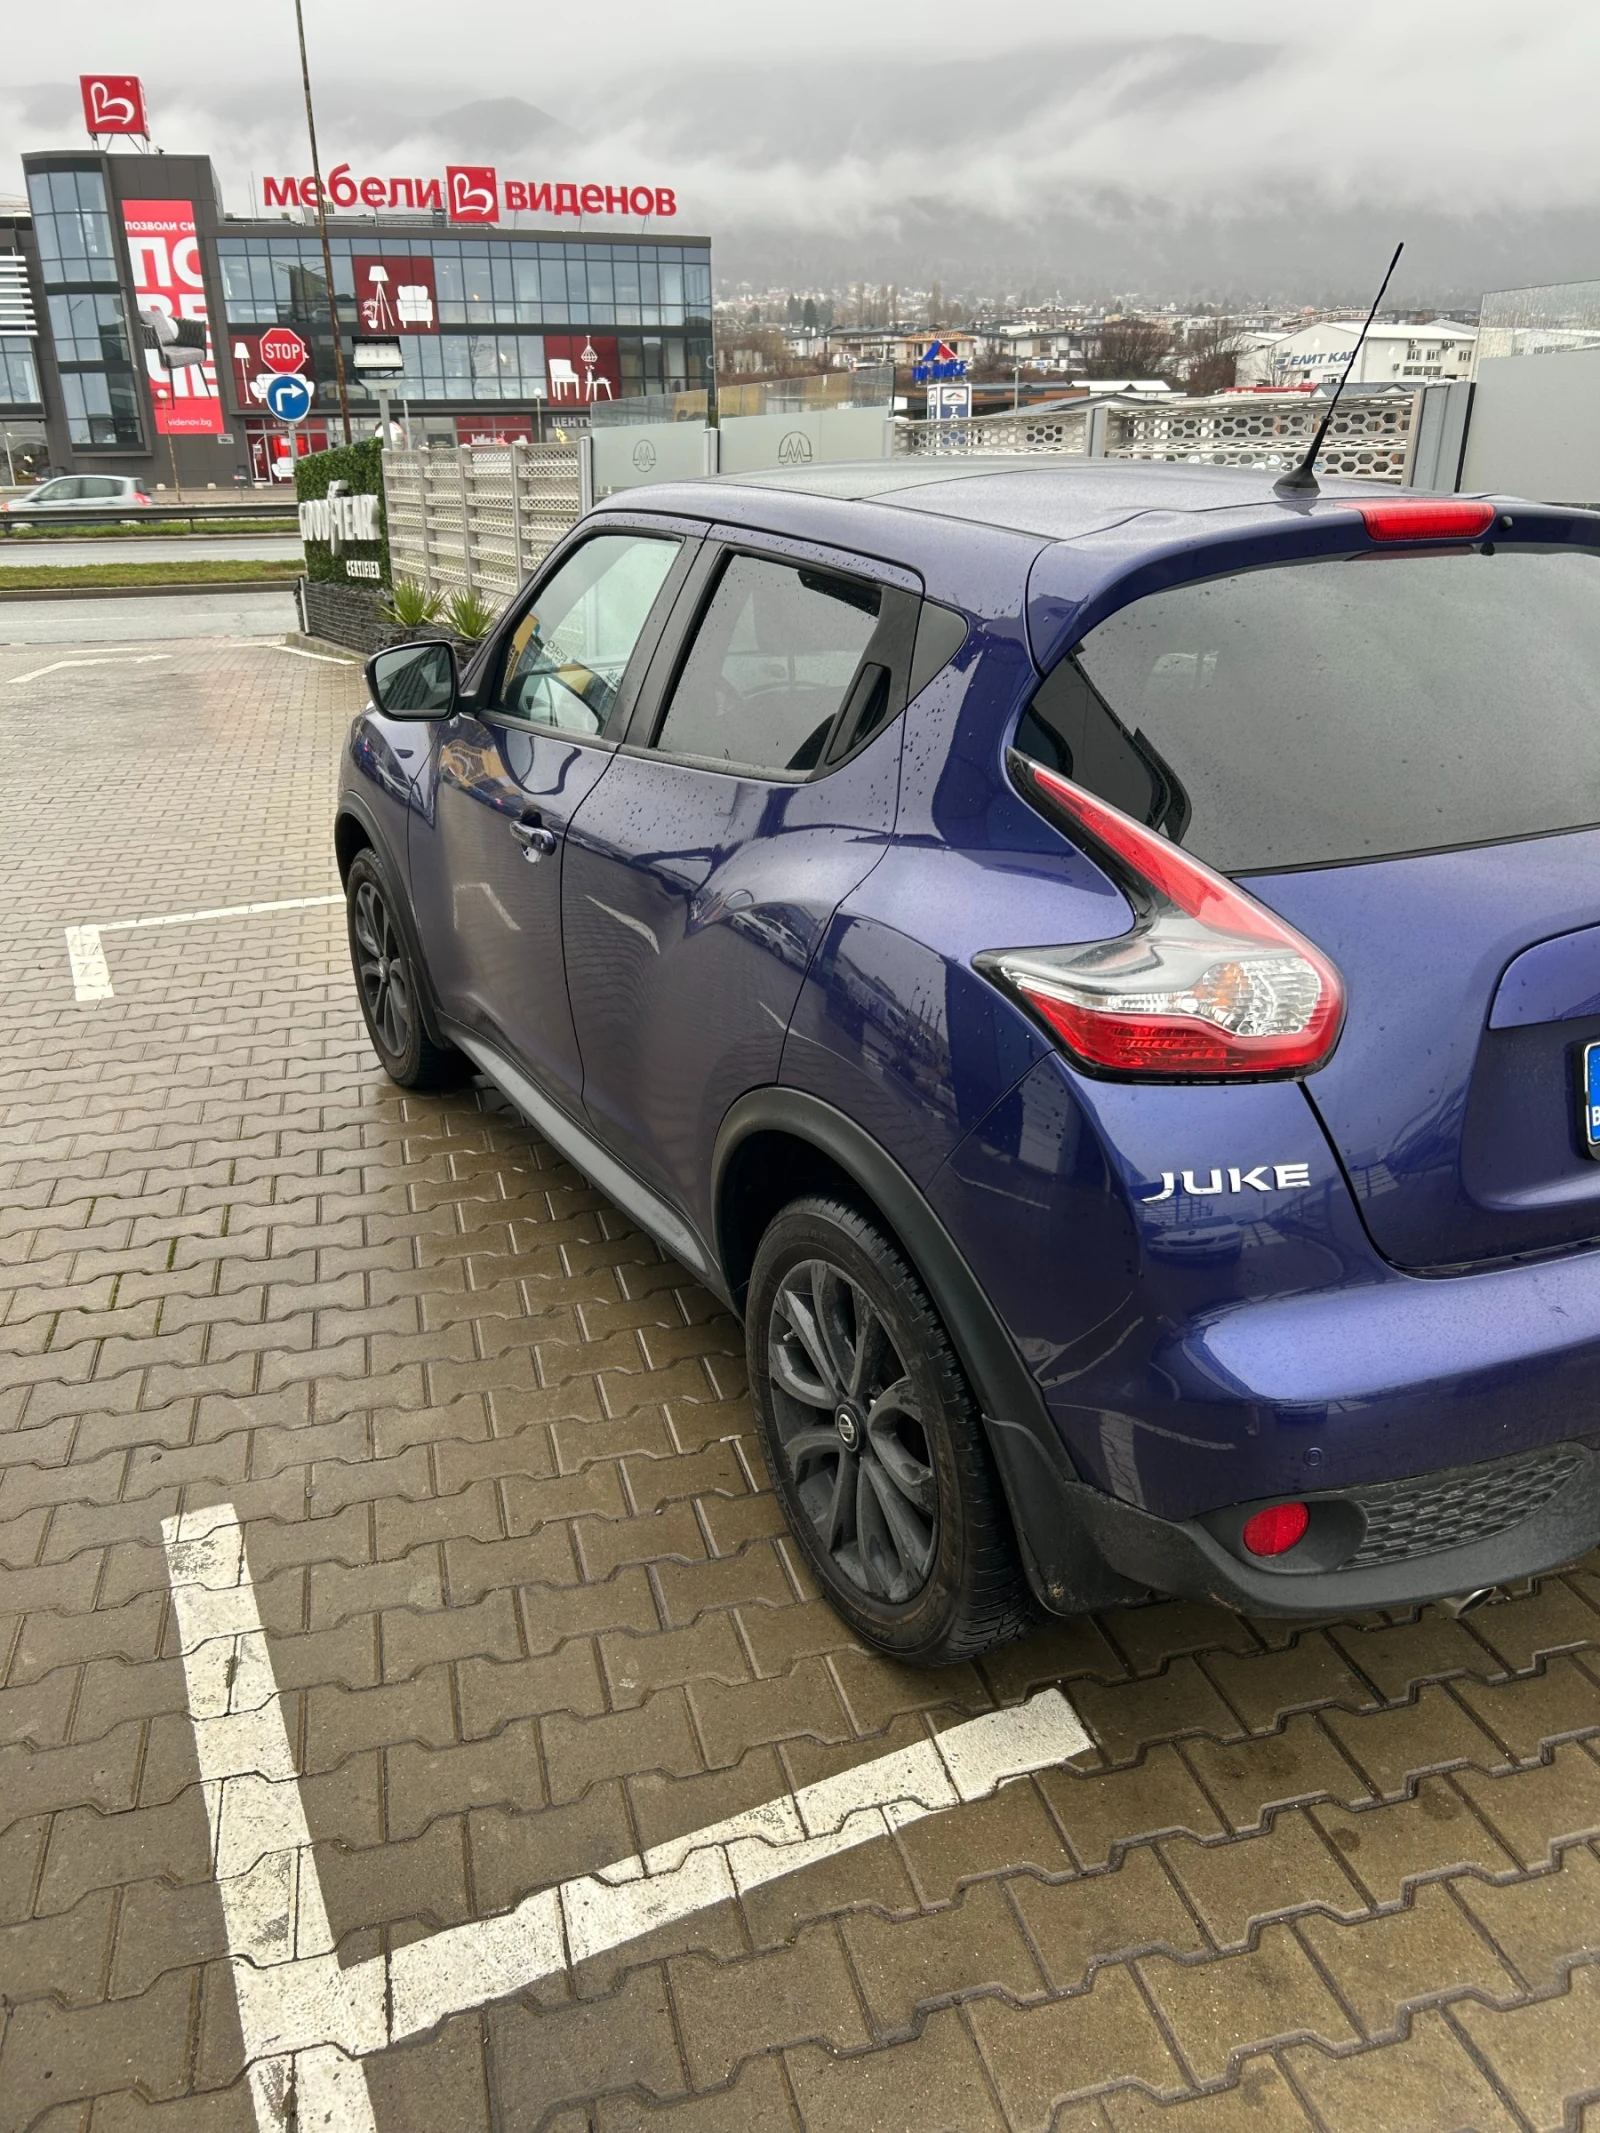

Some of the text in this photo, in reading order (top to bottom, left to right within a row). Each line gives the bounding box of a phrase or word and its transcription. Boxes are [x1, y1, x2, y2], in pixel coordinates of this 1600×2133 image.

[263, 163, 677, 216] мебели виденов
[124, 221, 197, 231] ПОЗВОЛИ СИ
[265, 343, 301, 360] STOP
[168, 418, 213, 428] videnov.bg
[1142, 1163, 1311, 1203] JUKE
